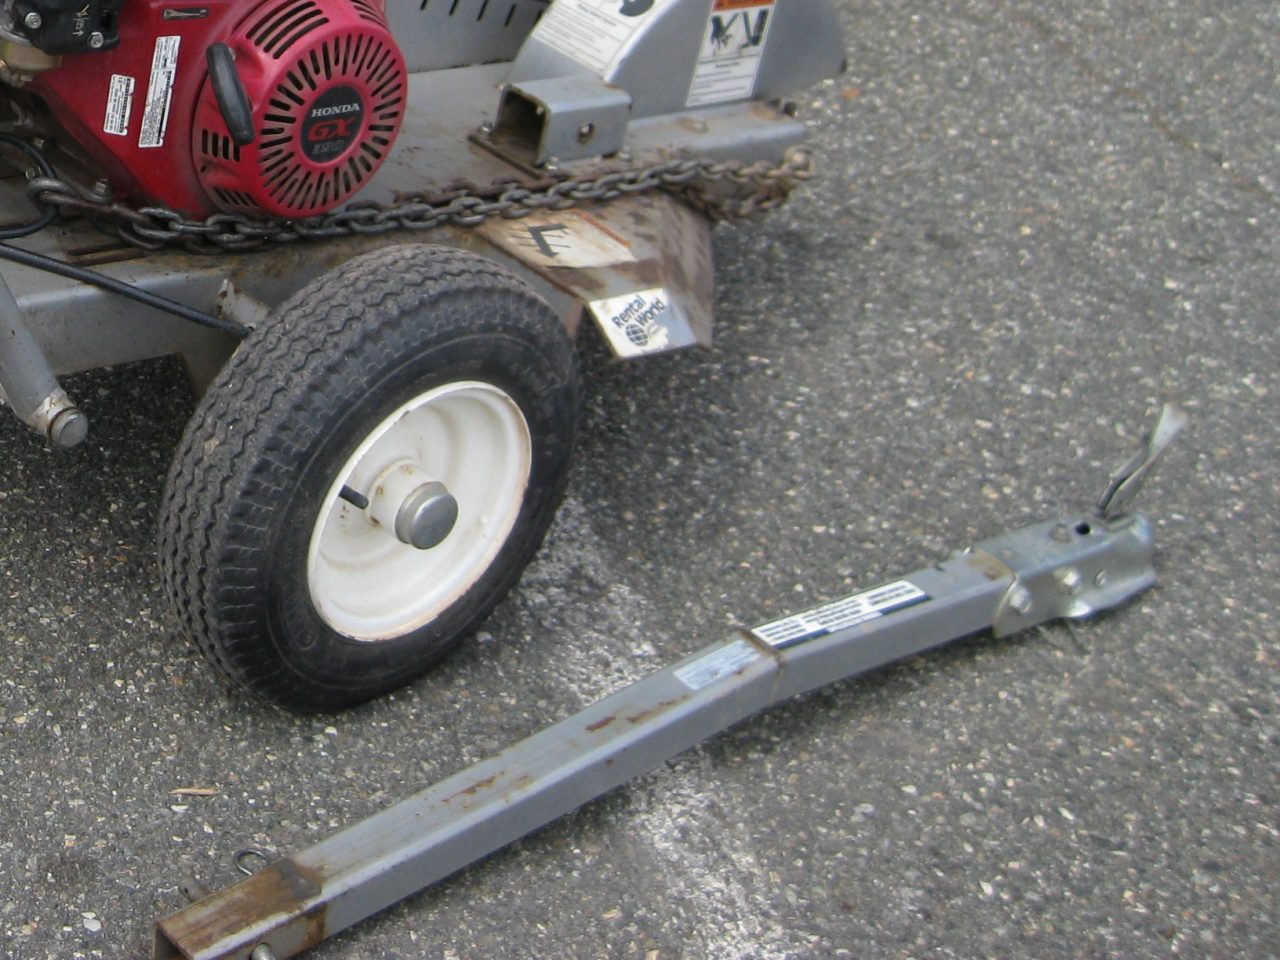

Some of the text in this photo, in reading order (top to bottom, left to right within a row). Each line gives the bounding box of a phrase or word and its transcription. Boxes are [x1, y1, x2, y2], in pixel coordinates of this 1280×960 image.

[311, 103, 361, 118] HONDA
[308, 116, 356, 142] GX
[611, 294, 647, 328] Rental
[634, 297, 666, 327] World
